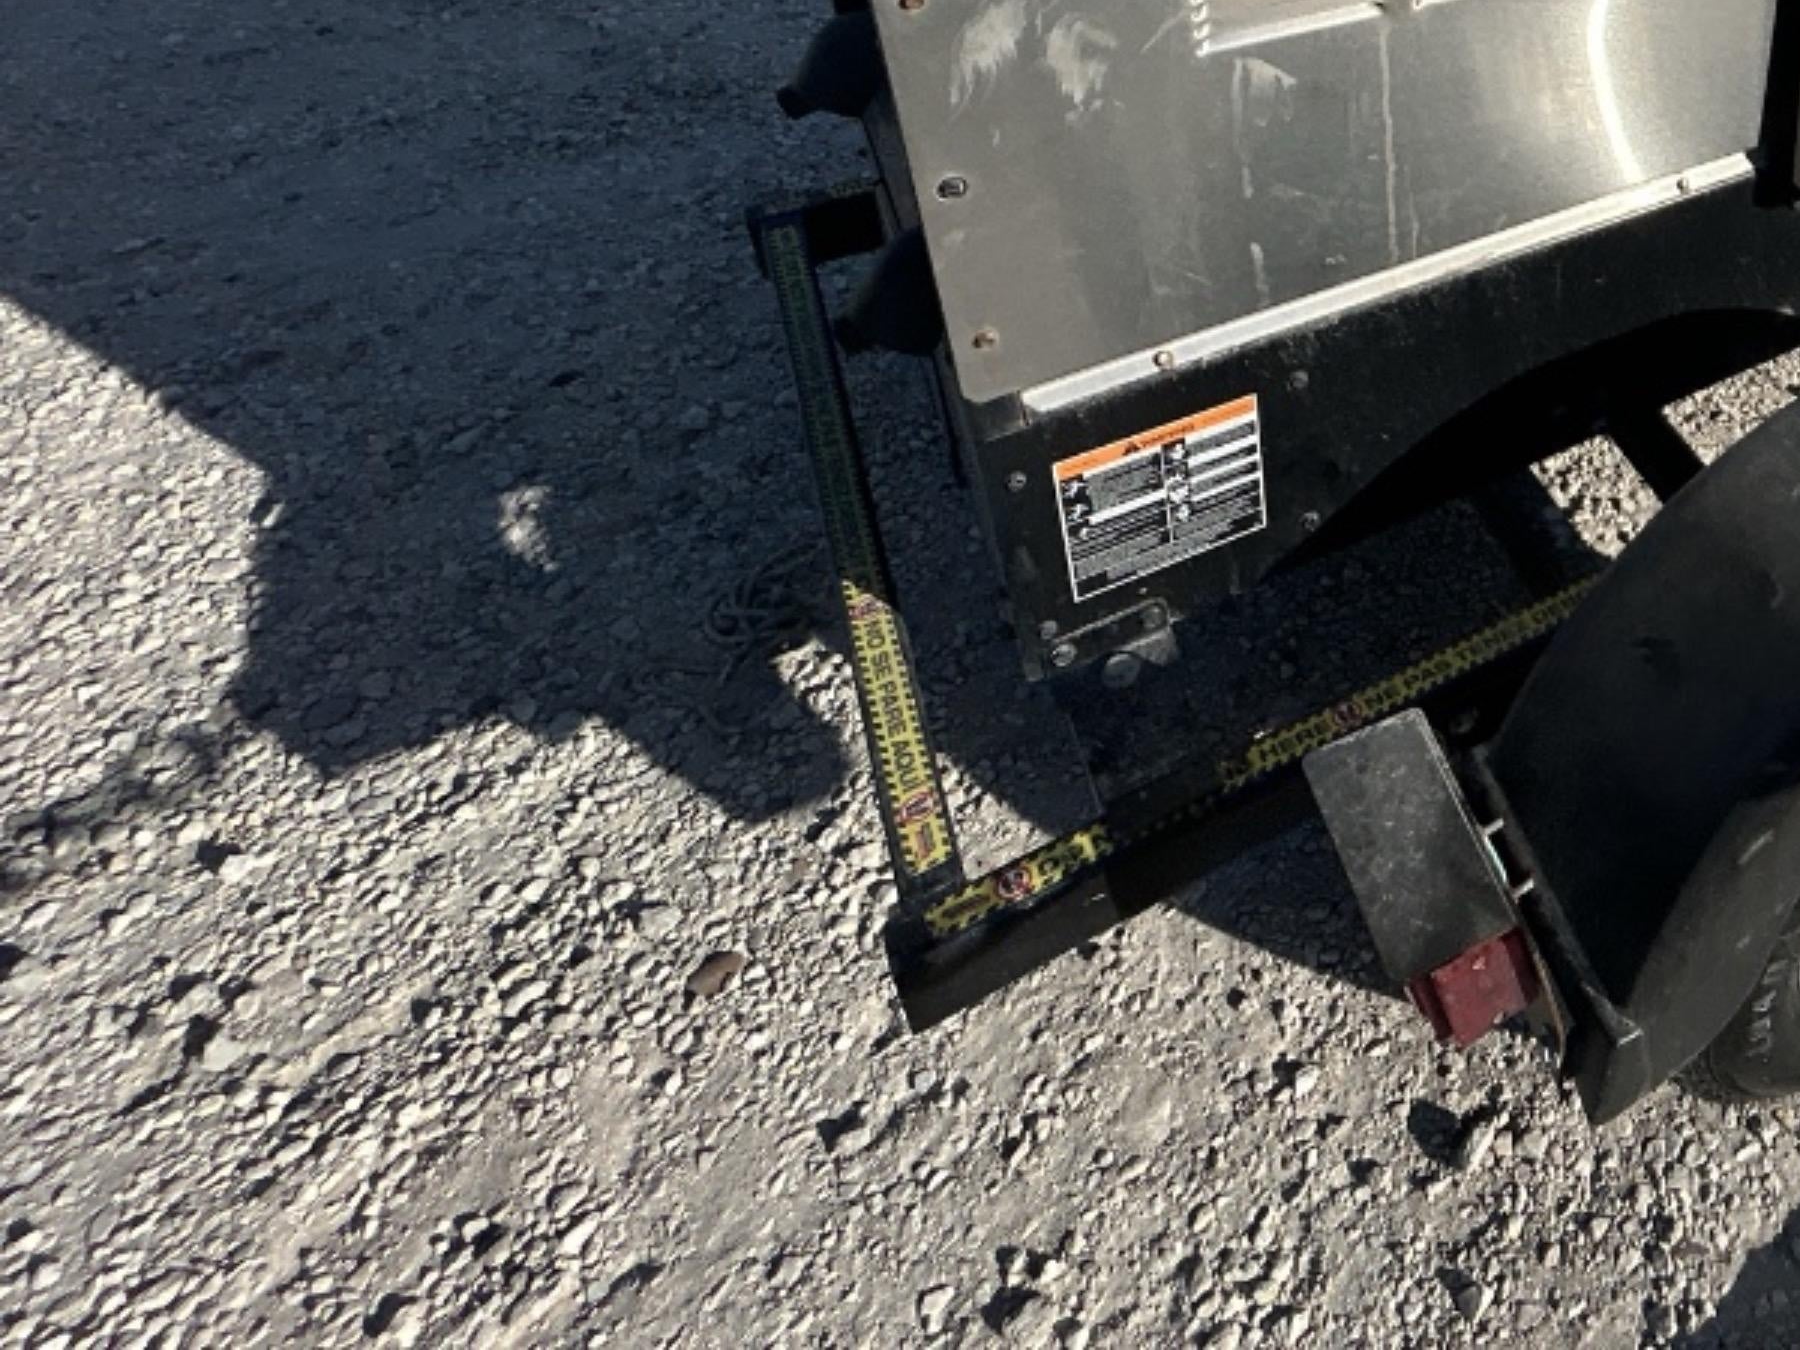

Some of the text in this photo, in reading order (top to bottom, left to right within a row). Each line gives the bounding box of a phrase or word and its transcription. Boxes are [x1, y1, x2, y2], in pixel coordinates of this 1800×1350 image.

[864, 618, 886, 650] NO
[869, 650, 894, 682] SE
[876, 681, 908, 739] PARE
